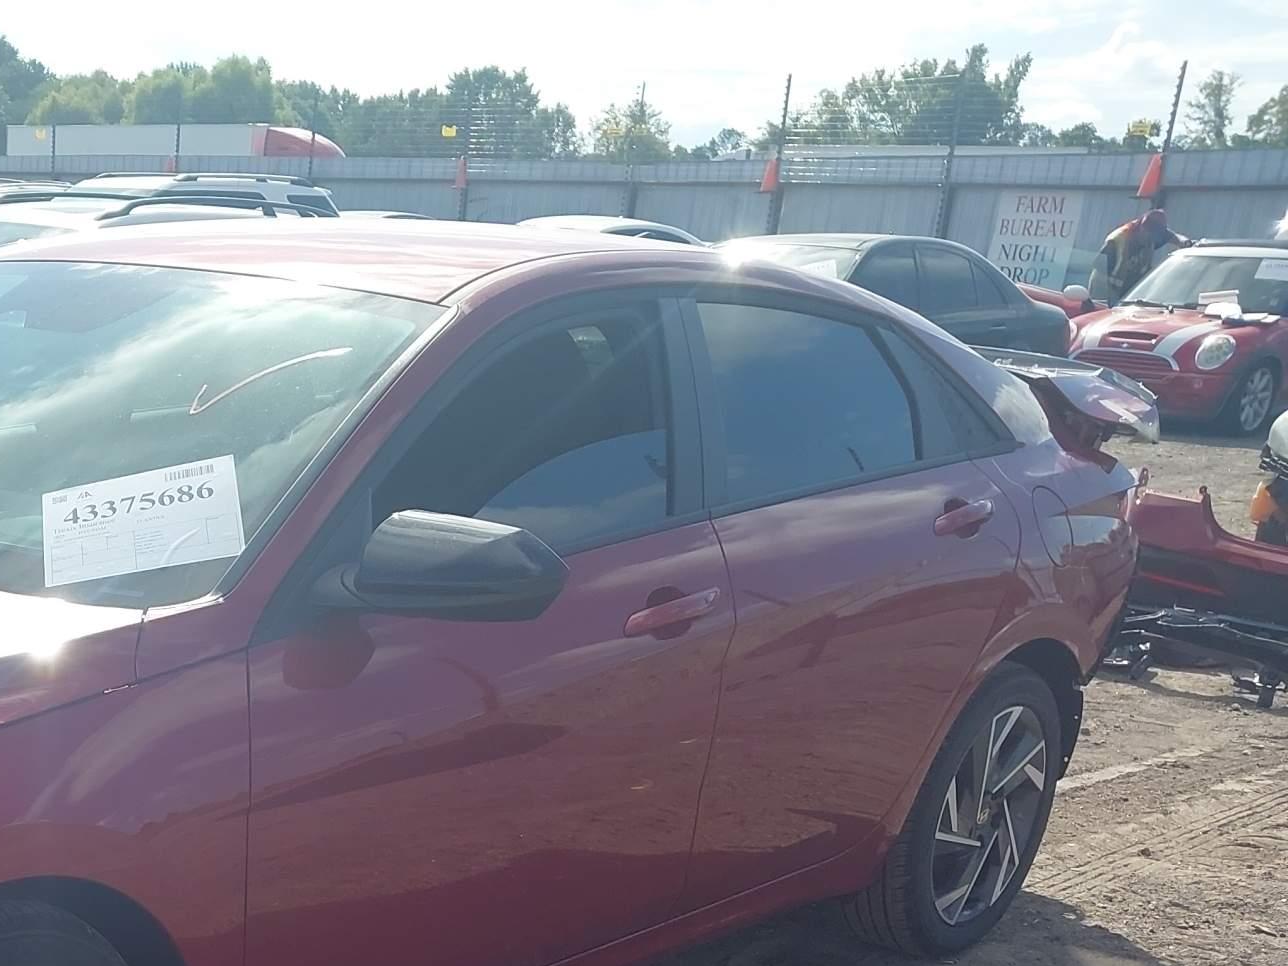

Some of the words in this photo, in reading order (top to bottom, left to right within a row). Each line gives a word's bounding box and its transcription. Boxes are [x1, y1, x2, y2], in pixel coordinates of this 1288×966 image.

[1015, 195, 1066, 215] FARM
[999, 218, 1074, 238] BUREAU
[998, 243, 1057, 263] NIGHT
[1000, 266, 1049, 285] DROP
[63, 480, 214, 525] 43375686
